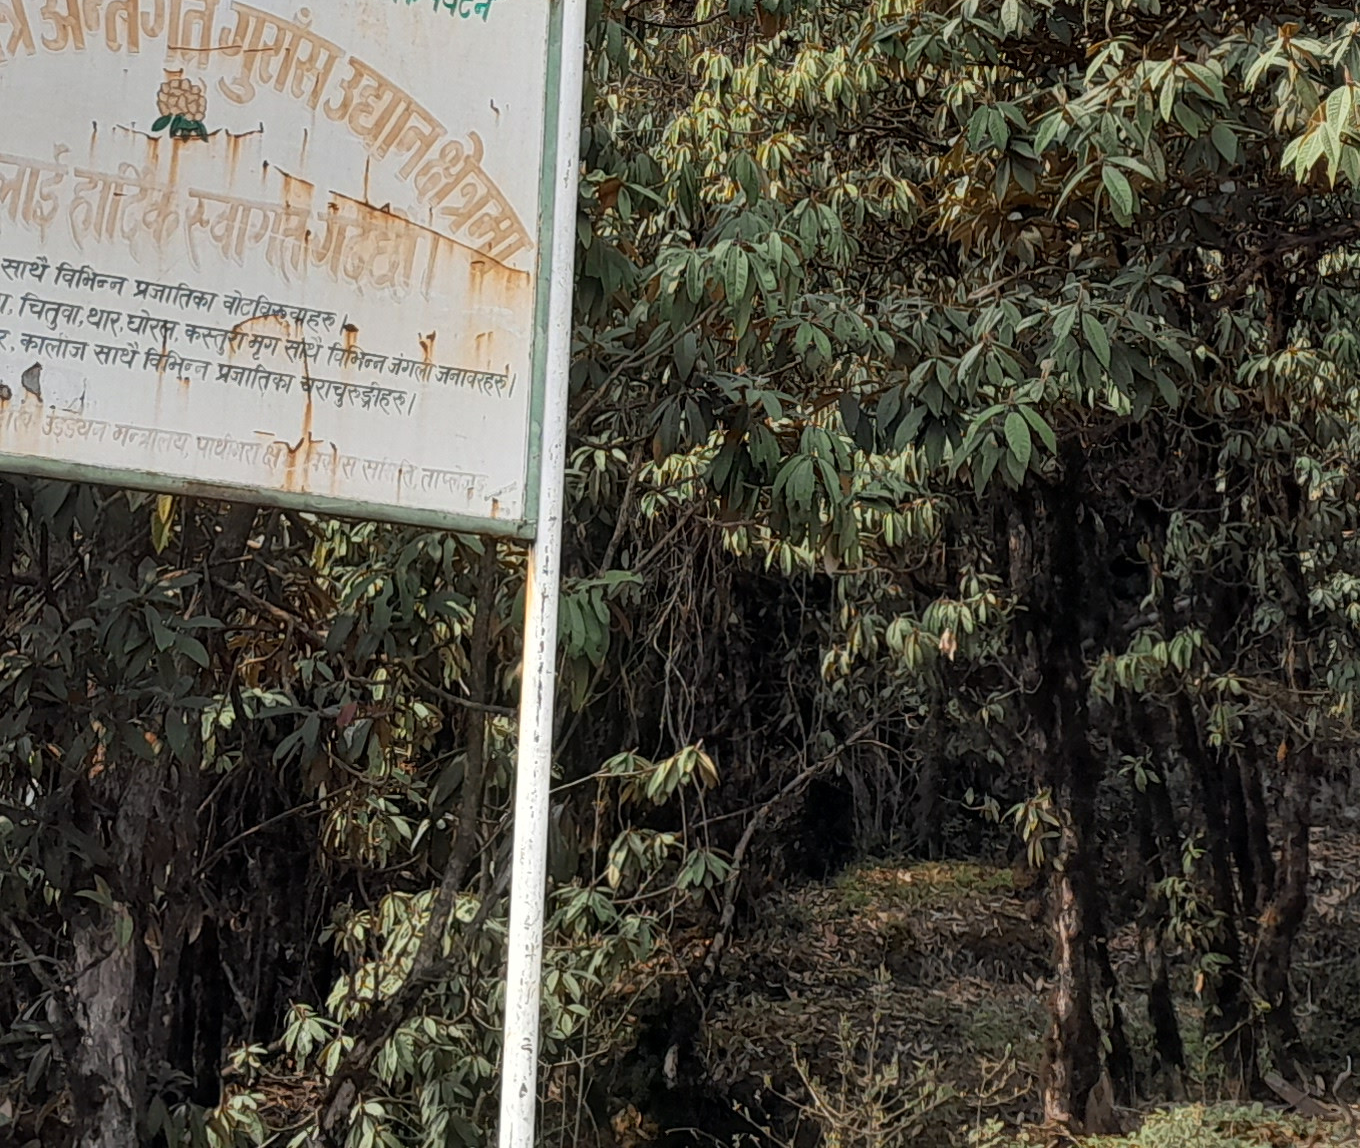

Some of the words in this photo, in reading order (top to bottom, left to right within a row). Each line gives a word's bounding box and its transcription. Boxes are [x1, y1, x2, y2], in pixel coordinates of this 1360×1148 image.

[218, 0, 348, 110] गुराँस
[324, 55, 448, 182] उद्यान
[414, 130, 534, 265] क्षेत्रमा
[186, 188, 310, 284] स्वागत
[1, 256, 50, 284] साथै
[54, 262, 129, 297] विभिन्न
[133, 279, 219, 313] प्रजातिका
[93, 341, 141, 372] साथै
[143, 346, 211, 379] विभिन्न
[215, 361, 295, 395] प्रजातिका
[248, 333, 280, 361] मृग
[328, 342, 387, 373] विभिन्न
